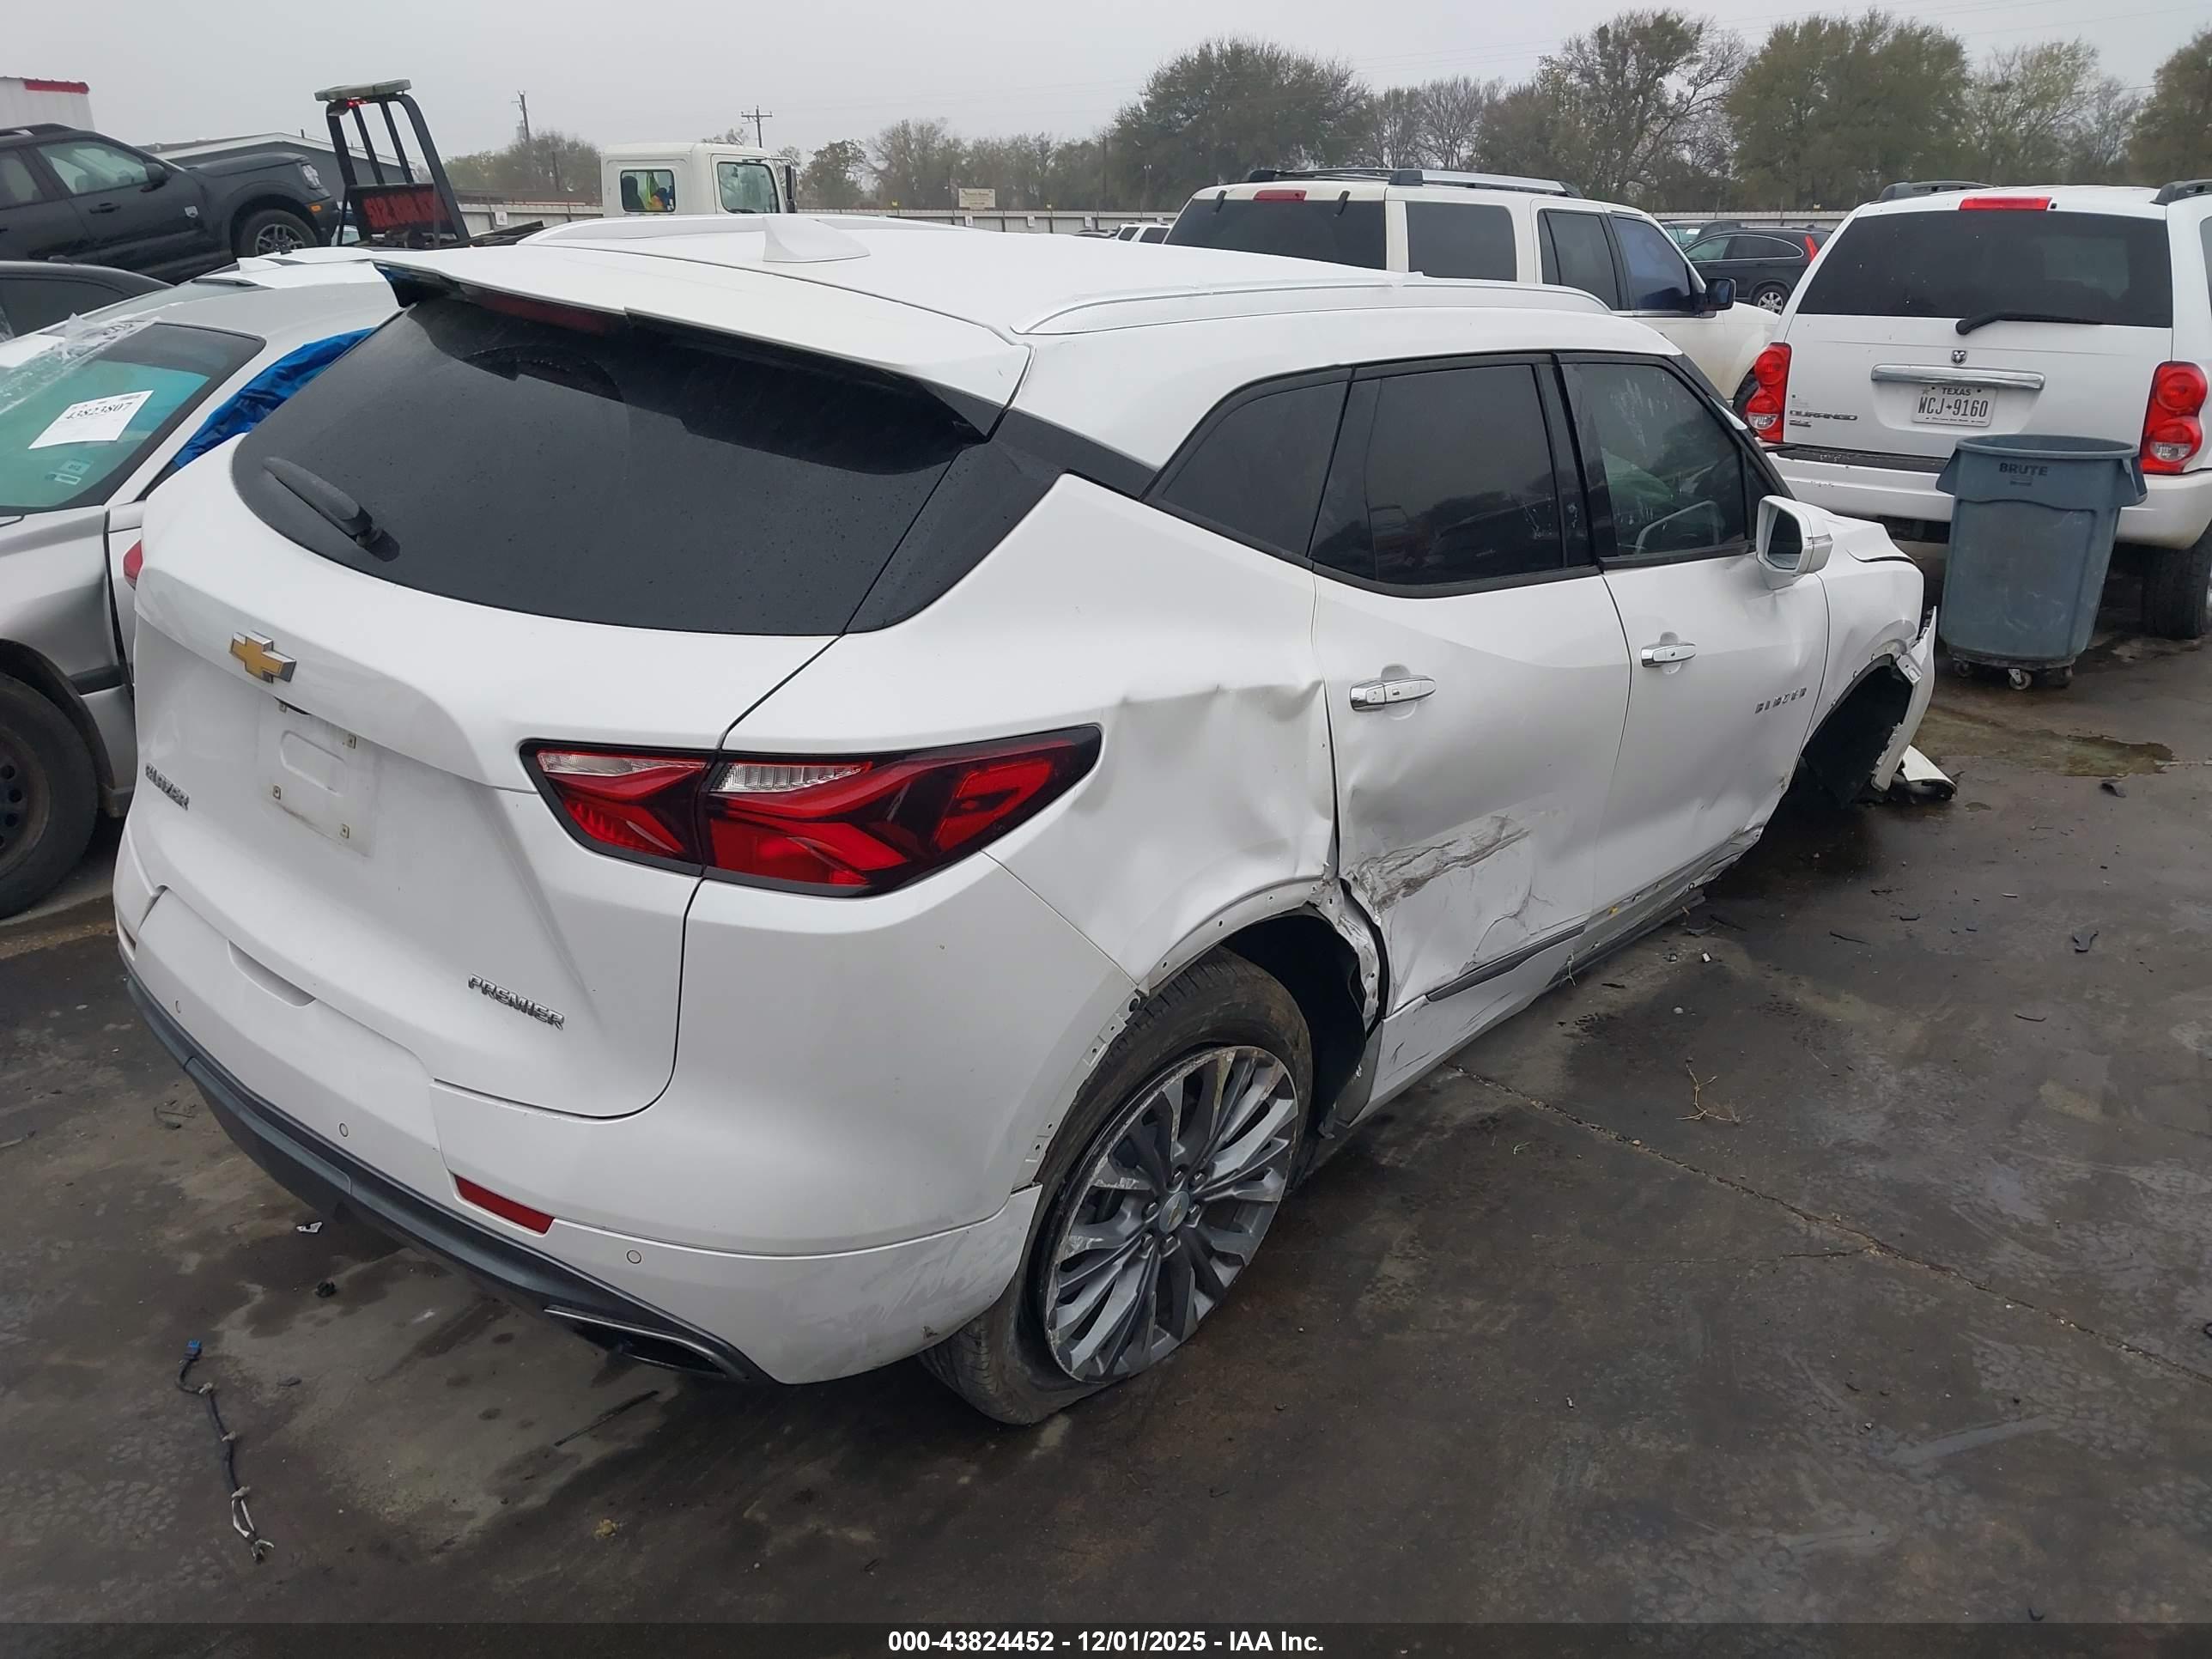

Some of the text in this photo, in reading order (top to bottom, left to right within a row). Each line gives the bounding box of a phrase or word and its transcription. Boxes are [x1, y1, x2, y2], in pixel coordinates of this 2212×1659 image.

[1942, 387, 1972, 396] TEXAS
[1999, 462, 2048, 476] BRUTE
[468, 973, 564, 1031] PREMIER
